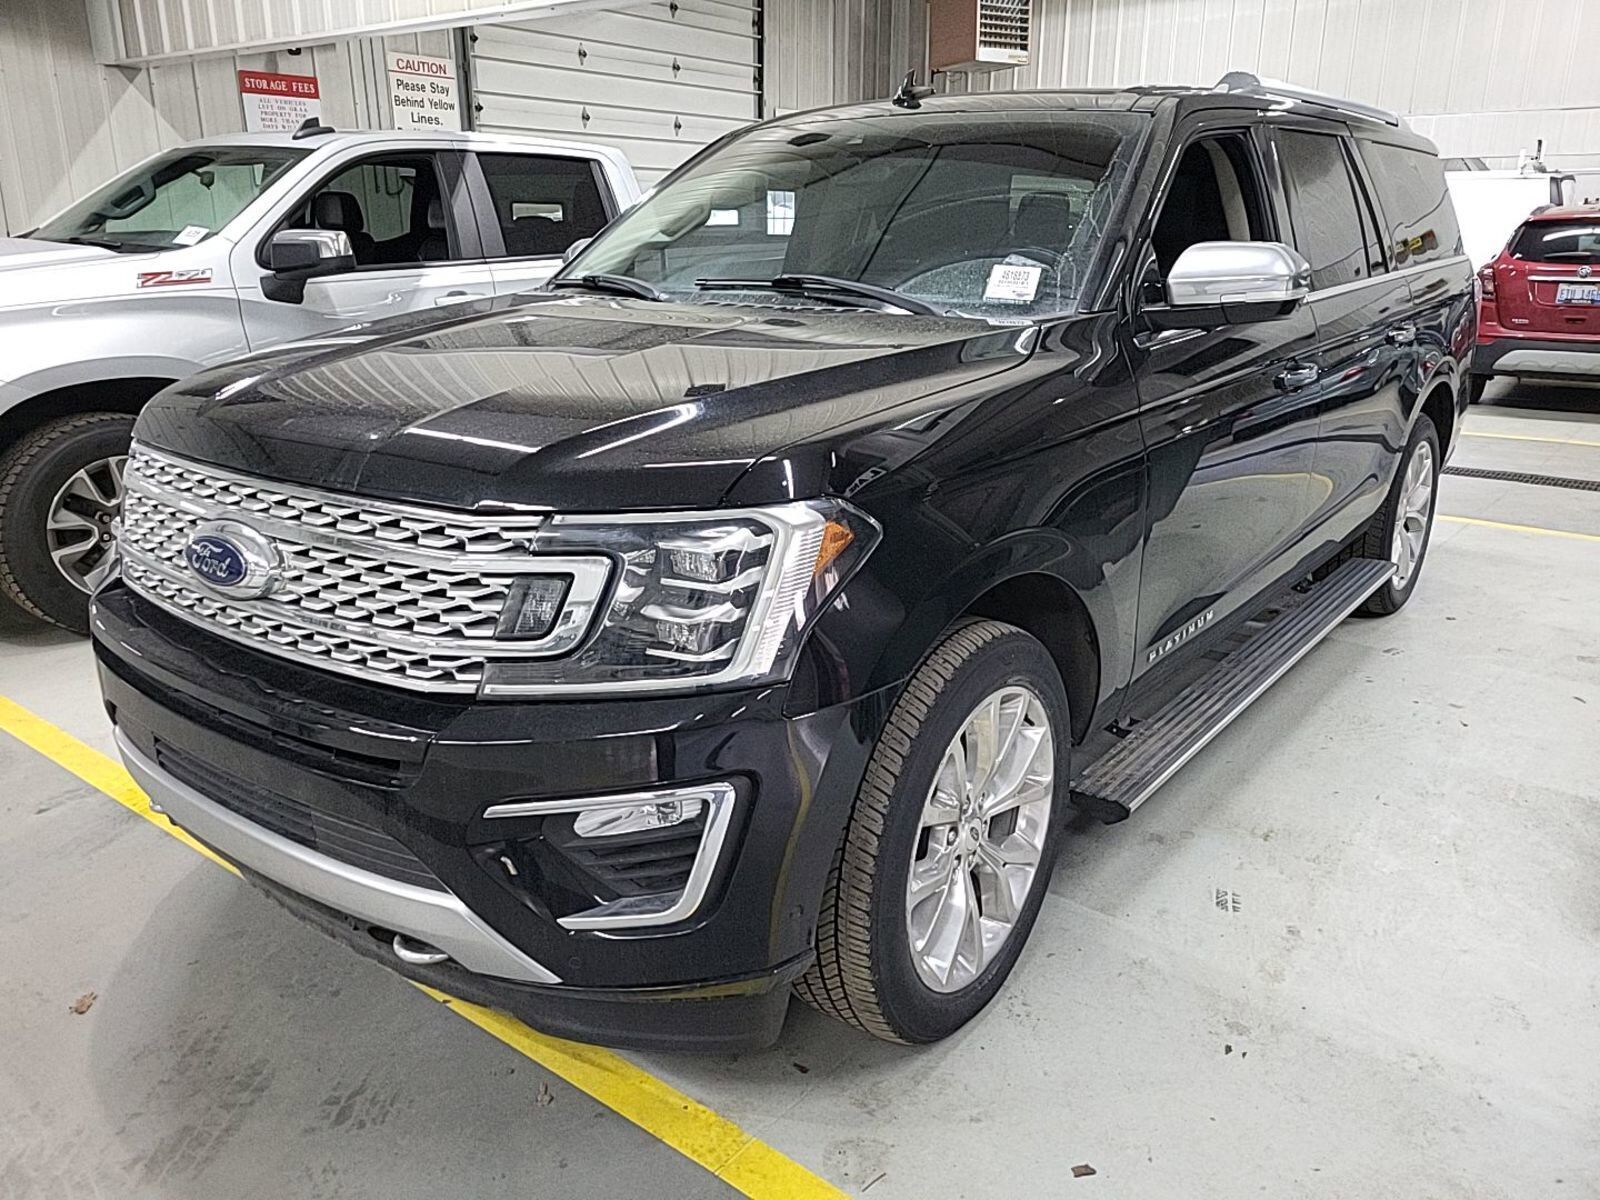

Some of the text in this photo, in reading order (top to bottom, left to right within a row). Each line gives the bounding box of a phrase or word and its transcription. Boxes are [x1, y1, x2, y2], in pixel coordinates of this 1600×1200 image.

[396, 58, 447, 74] CAUTION
[244, 78, 316, 94] STORAGE FEES
[396, 78, 450, 97] Please Stay
[394, 95, 455, 111] Behind Yellow
[411, 112, 444, 126] Lines.
[191, 541, 232, 578] Ford
[1149, 610, 1214, 663] PLATINUM
